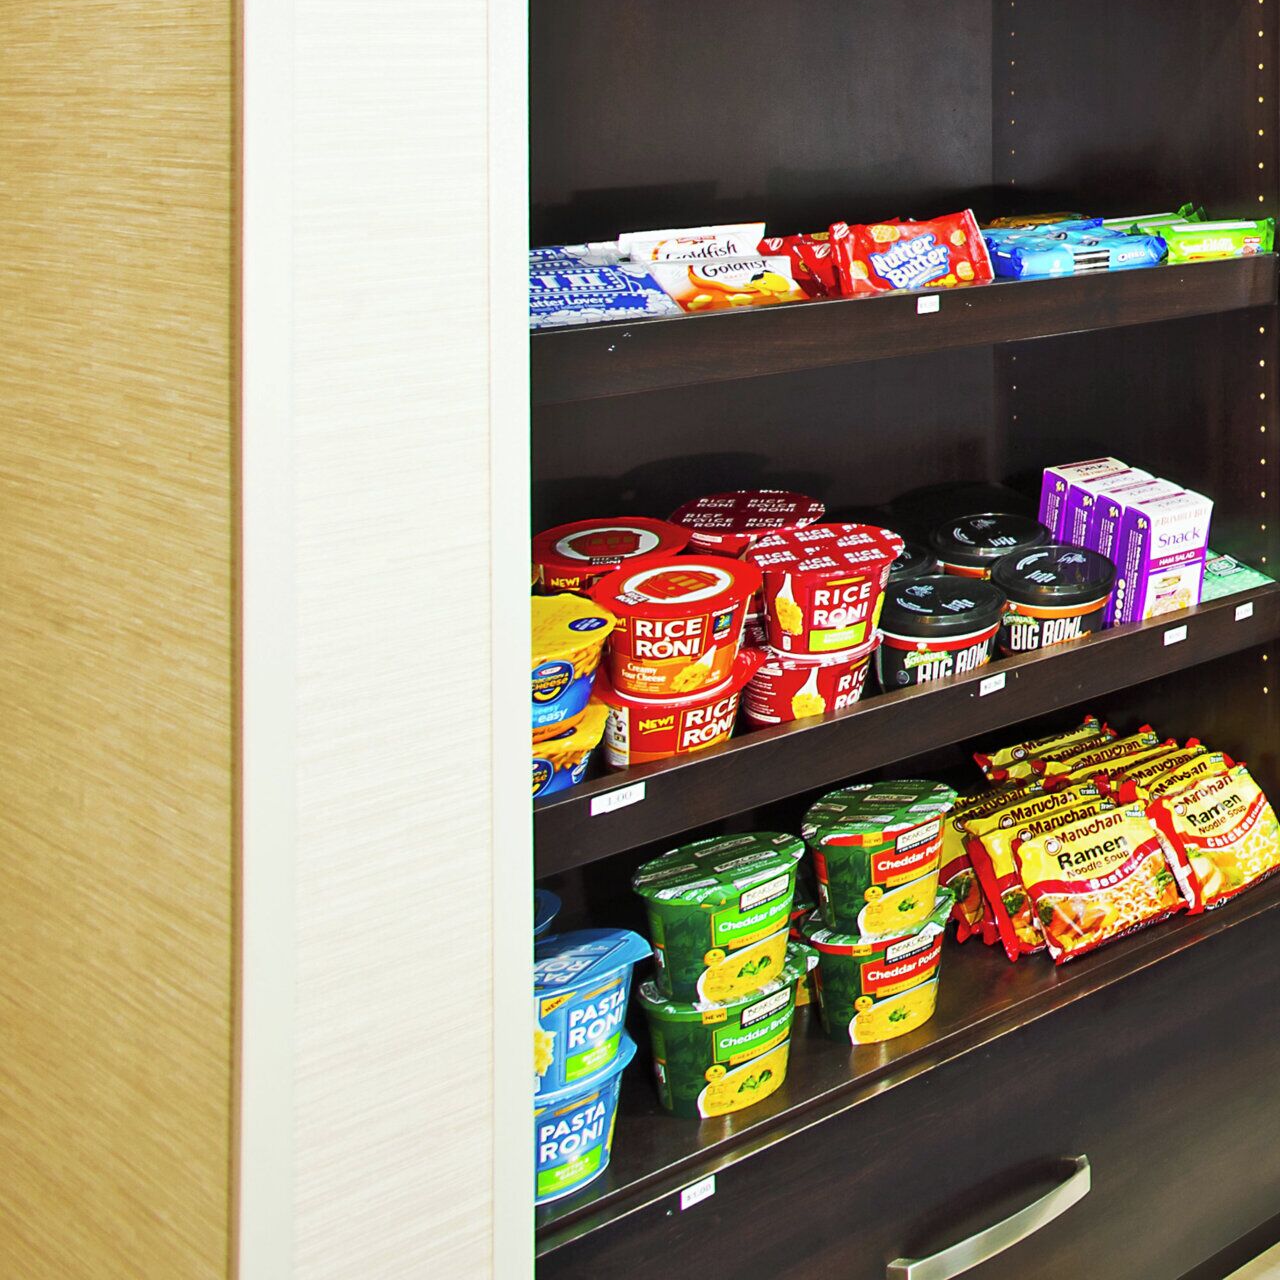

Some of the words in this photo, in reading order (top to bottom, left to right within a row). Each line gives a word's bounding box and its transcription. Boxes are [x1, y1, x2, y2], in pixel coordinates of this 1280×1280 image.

[874, 233, 934, 273] Nutter
[887, 248, 949, 289] Butter
[565, 294, 614, 308] Lovers
[1157, 526, 1201, 549] Snack
[813, 581, 873, 607] RICE
[635, 617, 703, 639] RICE
[813, 601, 869, 626] RONI
[636, 635, 701, 659] RONI
[1010, 620, 1039, 651] BIG
[1041, 615, 1083, 650] BOWL
[638, 714, 675, 733] NEW!
[685, 692, 738, 729] RICE
[682, 711, 735, 748] RONI
[1081, 739, 1142, 767] Maruchan
[1132, 753, 1192, 781] Maruchan
[1010, 790, 1077, 822] Maruchan
[1028, 805, 1097, 836] Maruchan
[1186, 793, 1242, 828] Ramen
[1198, 815, 1227, 835] Noodle
[1227, 804, 1248, 819] Soup
[1055, 813, 1123, 845] Maruchan
[877, 851, 925, 872] Cheddar
[1057, 835, 1128, 870] Ramen
[1066, 859, 1103, 878] Noodle
[1104, 850, 1131, 866] Soup
[1090, 871, 1124, 891] Beef
[718, 911, 768, 933] Cheddar
[866, 962, 918, 982] Cheddar
[569, 986, 628, 1029] PASTA
[568, 1004, 624, 1049] RONI
[719, 1028, 769, 1049] Cheddar
[539, 1100, 607, 1143] PASTA
[538, 1119, 604, 1164] RONI
